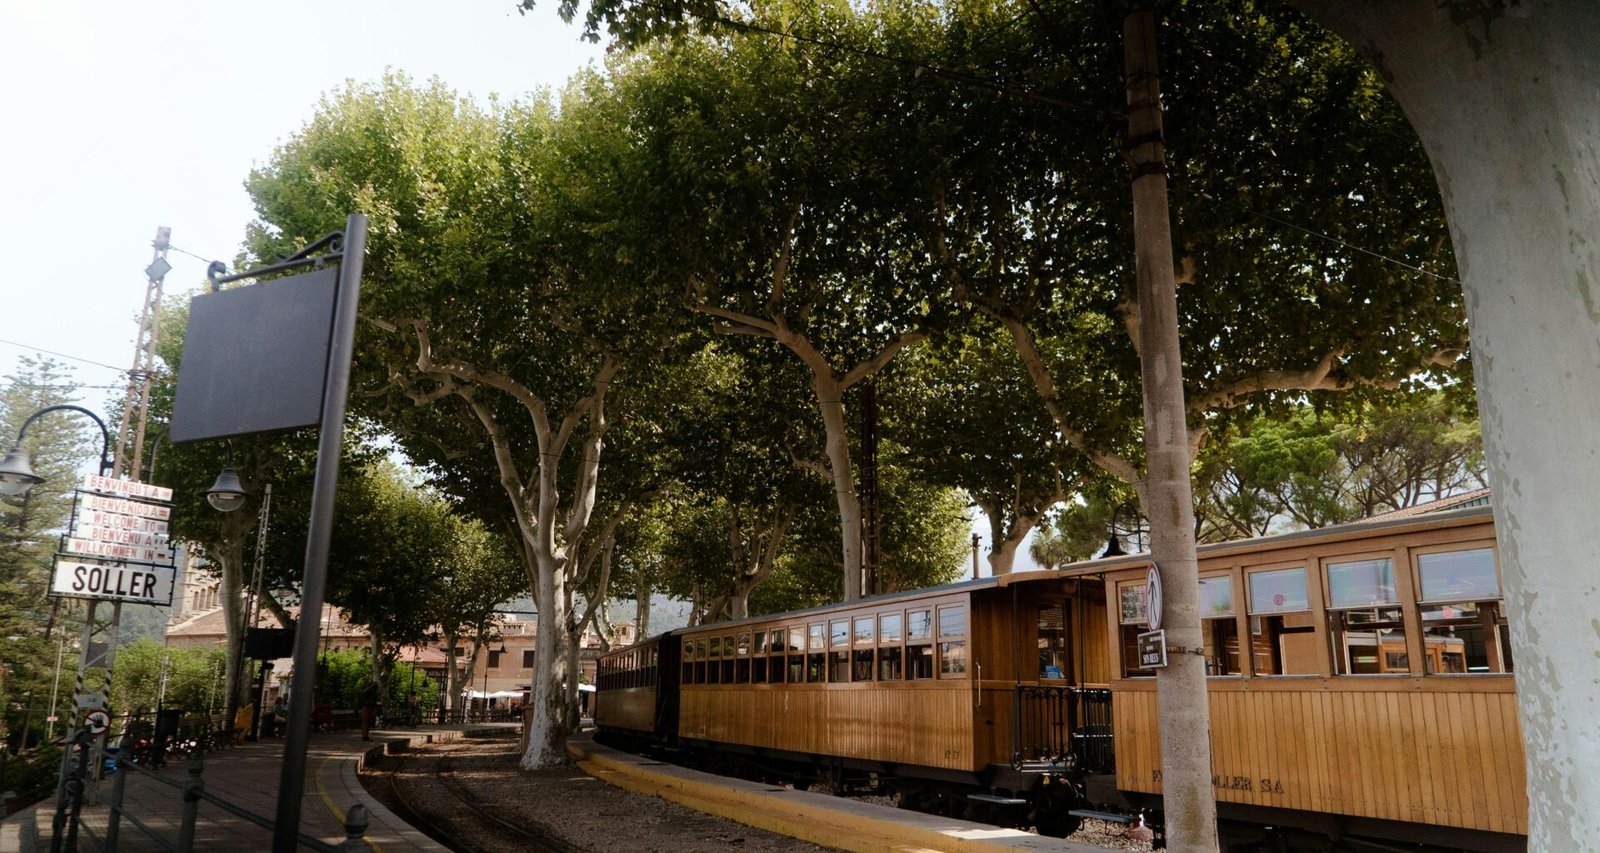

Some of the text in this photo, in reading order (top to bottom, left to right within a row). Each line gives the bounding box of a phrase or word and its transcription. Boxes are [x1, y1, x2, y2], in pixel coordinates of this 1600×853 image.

[90, 476, 159, 498] BENVINGUT A
[91, 498, 158, 517] BIENVENIDO A
[94, 512, 156, 532] WELCOME TO
[92, 528, 141, 543] BIENVENU
[74, 541, 154, 560] WILLKOMMEN IN
[72, 565, 157, 598] SOLLER
